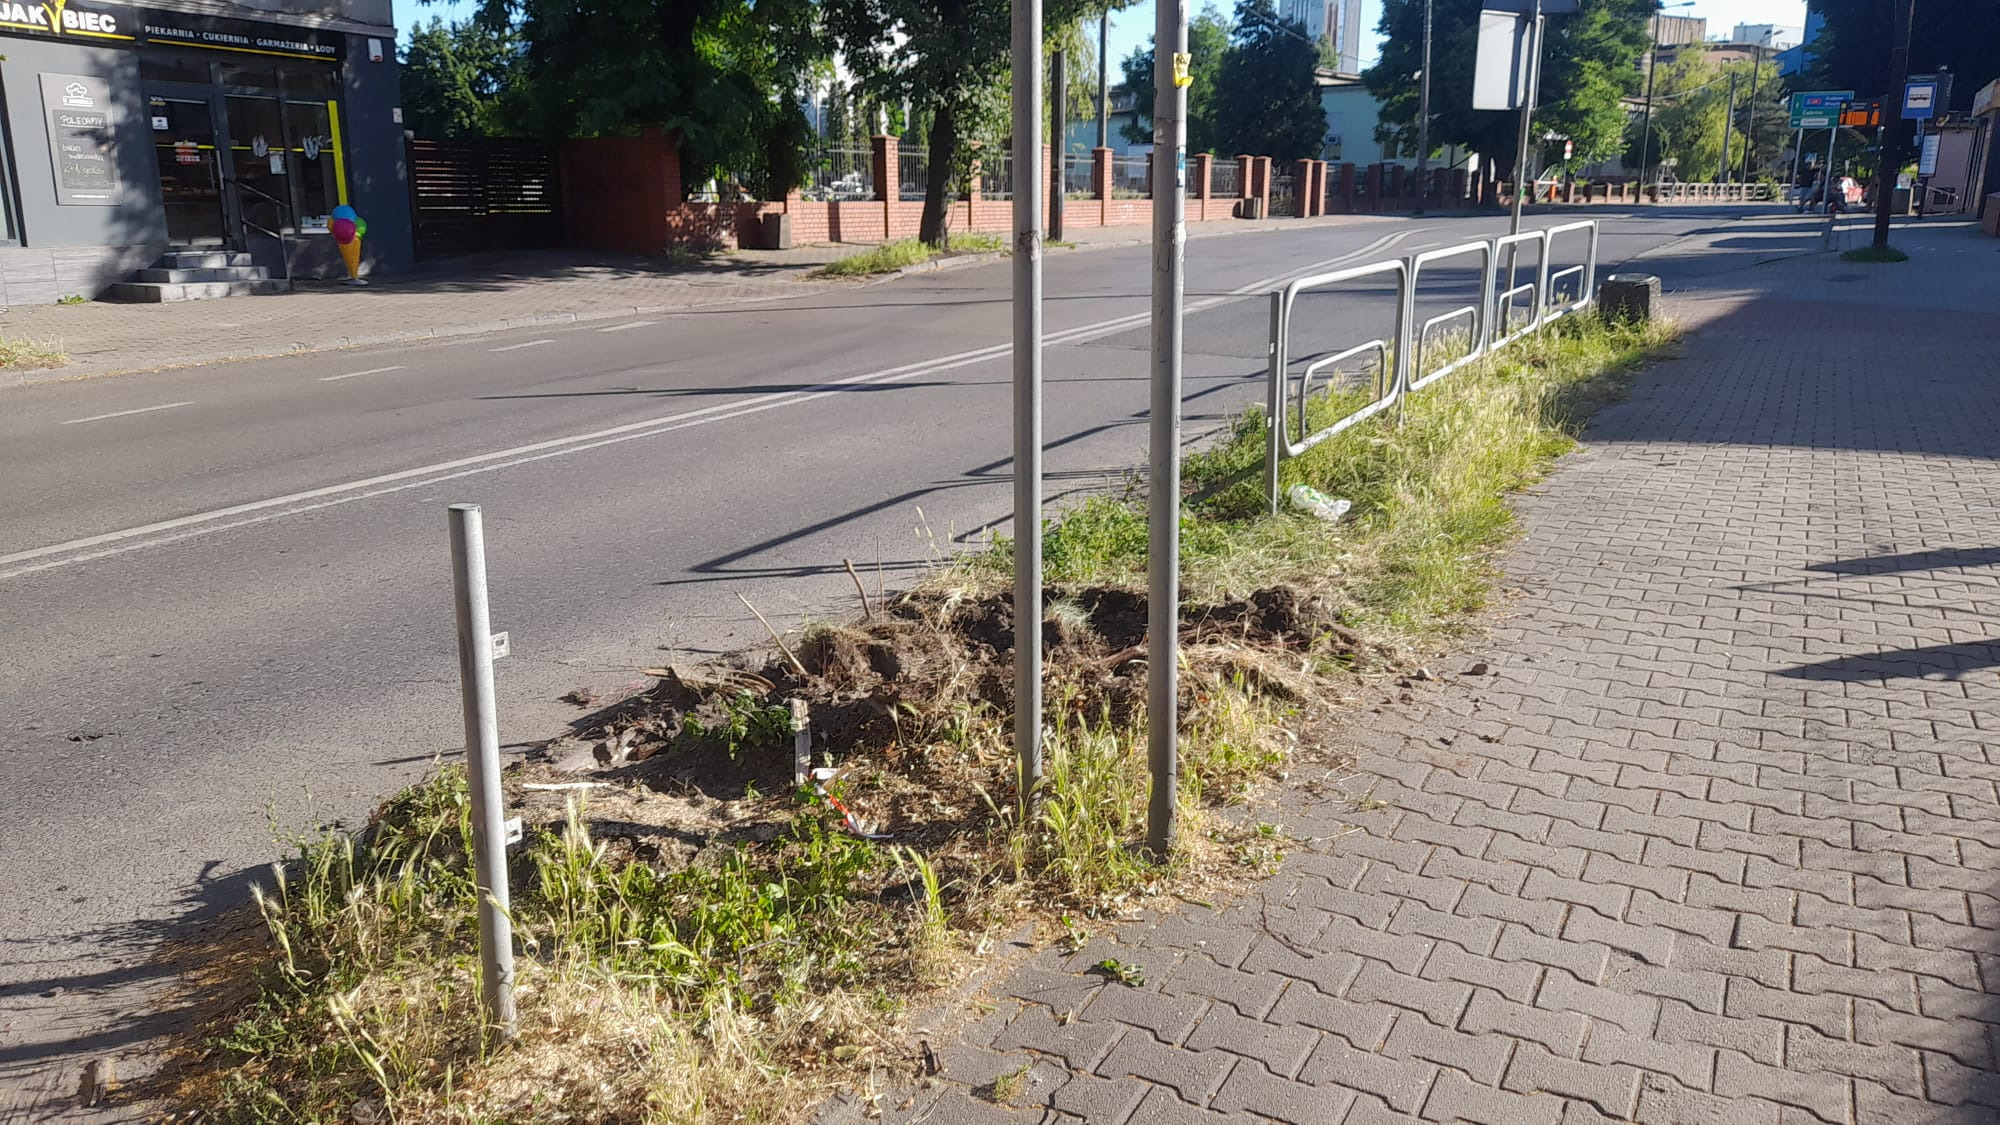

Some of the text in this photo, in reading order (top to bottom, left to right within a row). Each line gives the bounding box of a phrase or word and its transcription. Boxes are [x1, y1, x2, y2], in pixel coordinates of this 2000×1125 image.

[144, 25, 336, 54] PIEKARNIA CUKIERNIA GARMAŻERIA LODY
